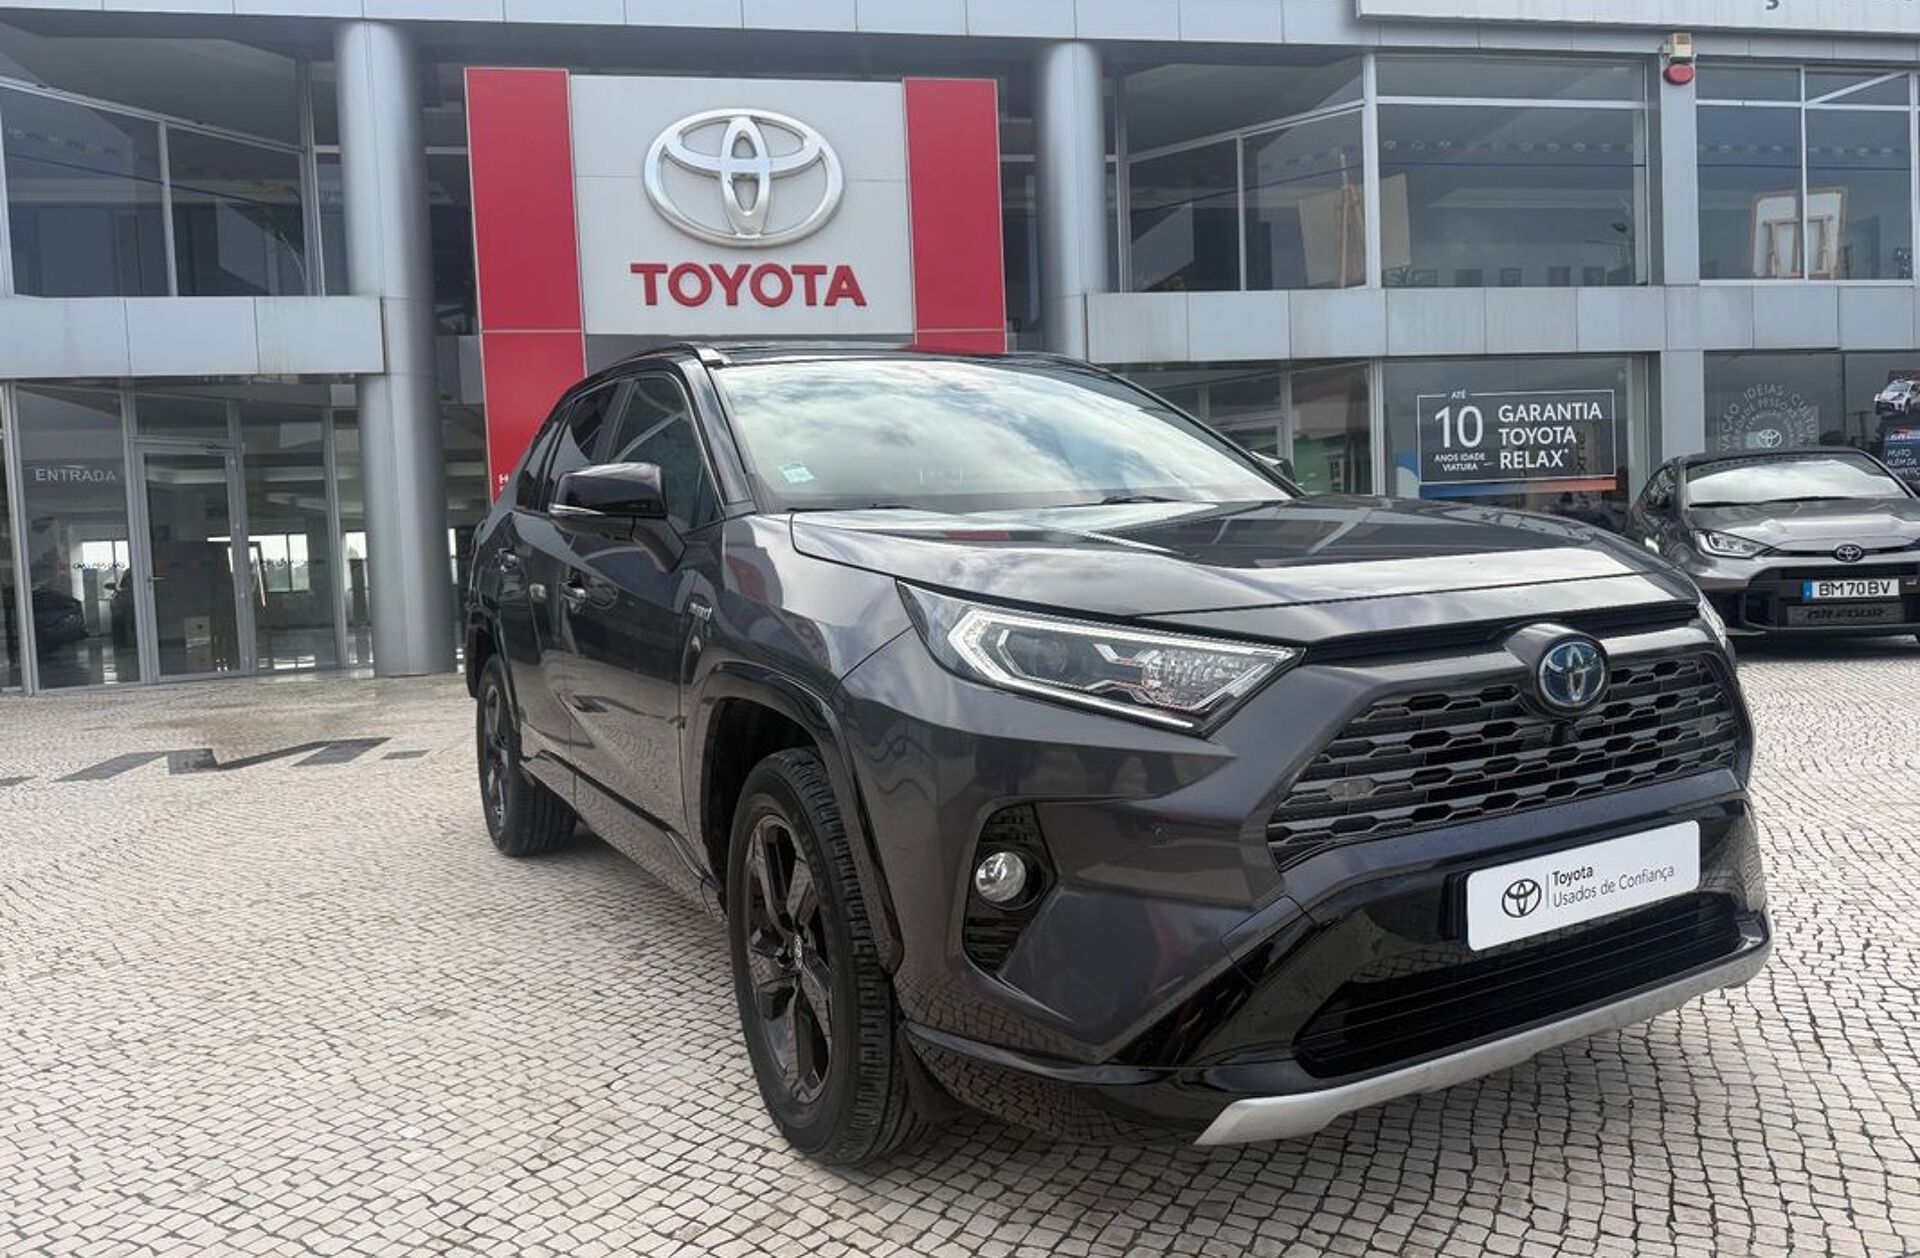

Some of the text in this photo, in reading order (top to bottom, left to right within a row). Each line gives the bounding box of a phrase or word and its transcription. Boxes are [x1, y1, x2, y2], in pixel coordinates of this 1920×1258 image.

[630, 262, 867, 308] TOYOTA
[1451, 389, 1467, 400] ATÉ
[1498, 402, 1603, 422] GARANTIA
[1434, 405, 1484, 449] 10
[1498, 426, 1577, 447] TOYOTA
[1434, 452, 1485, 462] ANOS IDADE
[35, 468, 117, 483] ENTRADA
[1442, 463, 1478, 472] VIATURA
[1818, 581, 1890, 597] BM70BV
[1552, 865, 1594, 888] Toyota
[1552, 863, 1675, 908] Usados de Confiança
